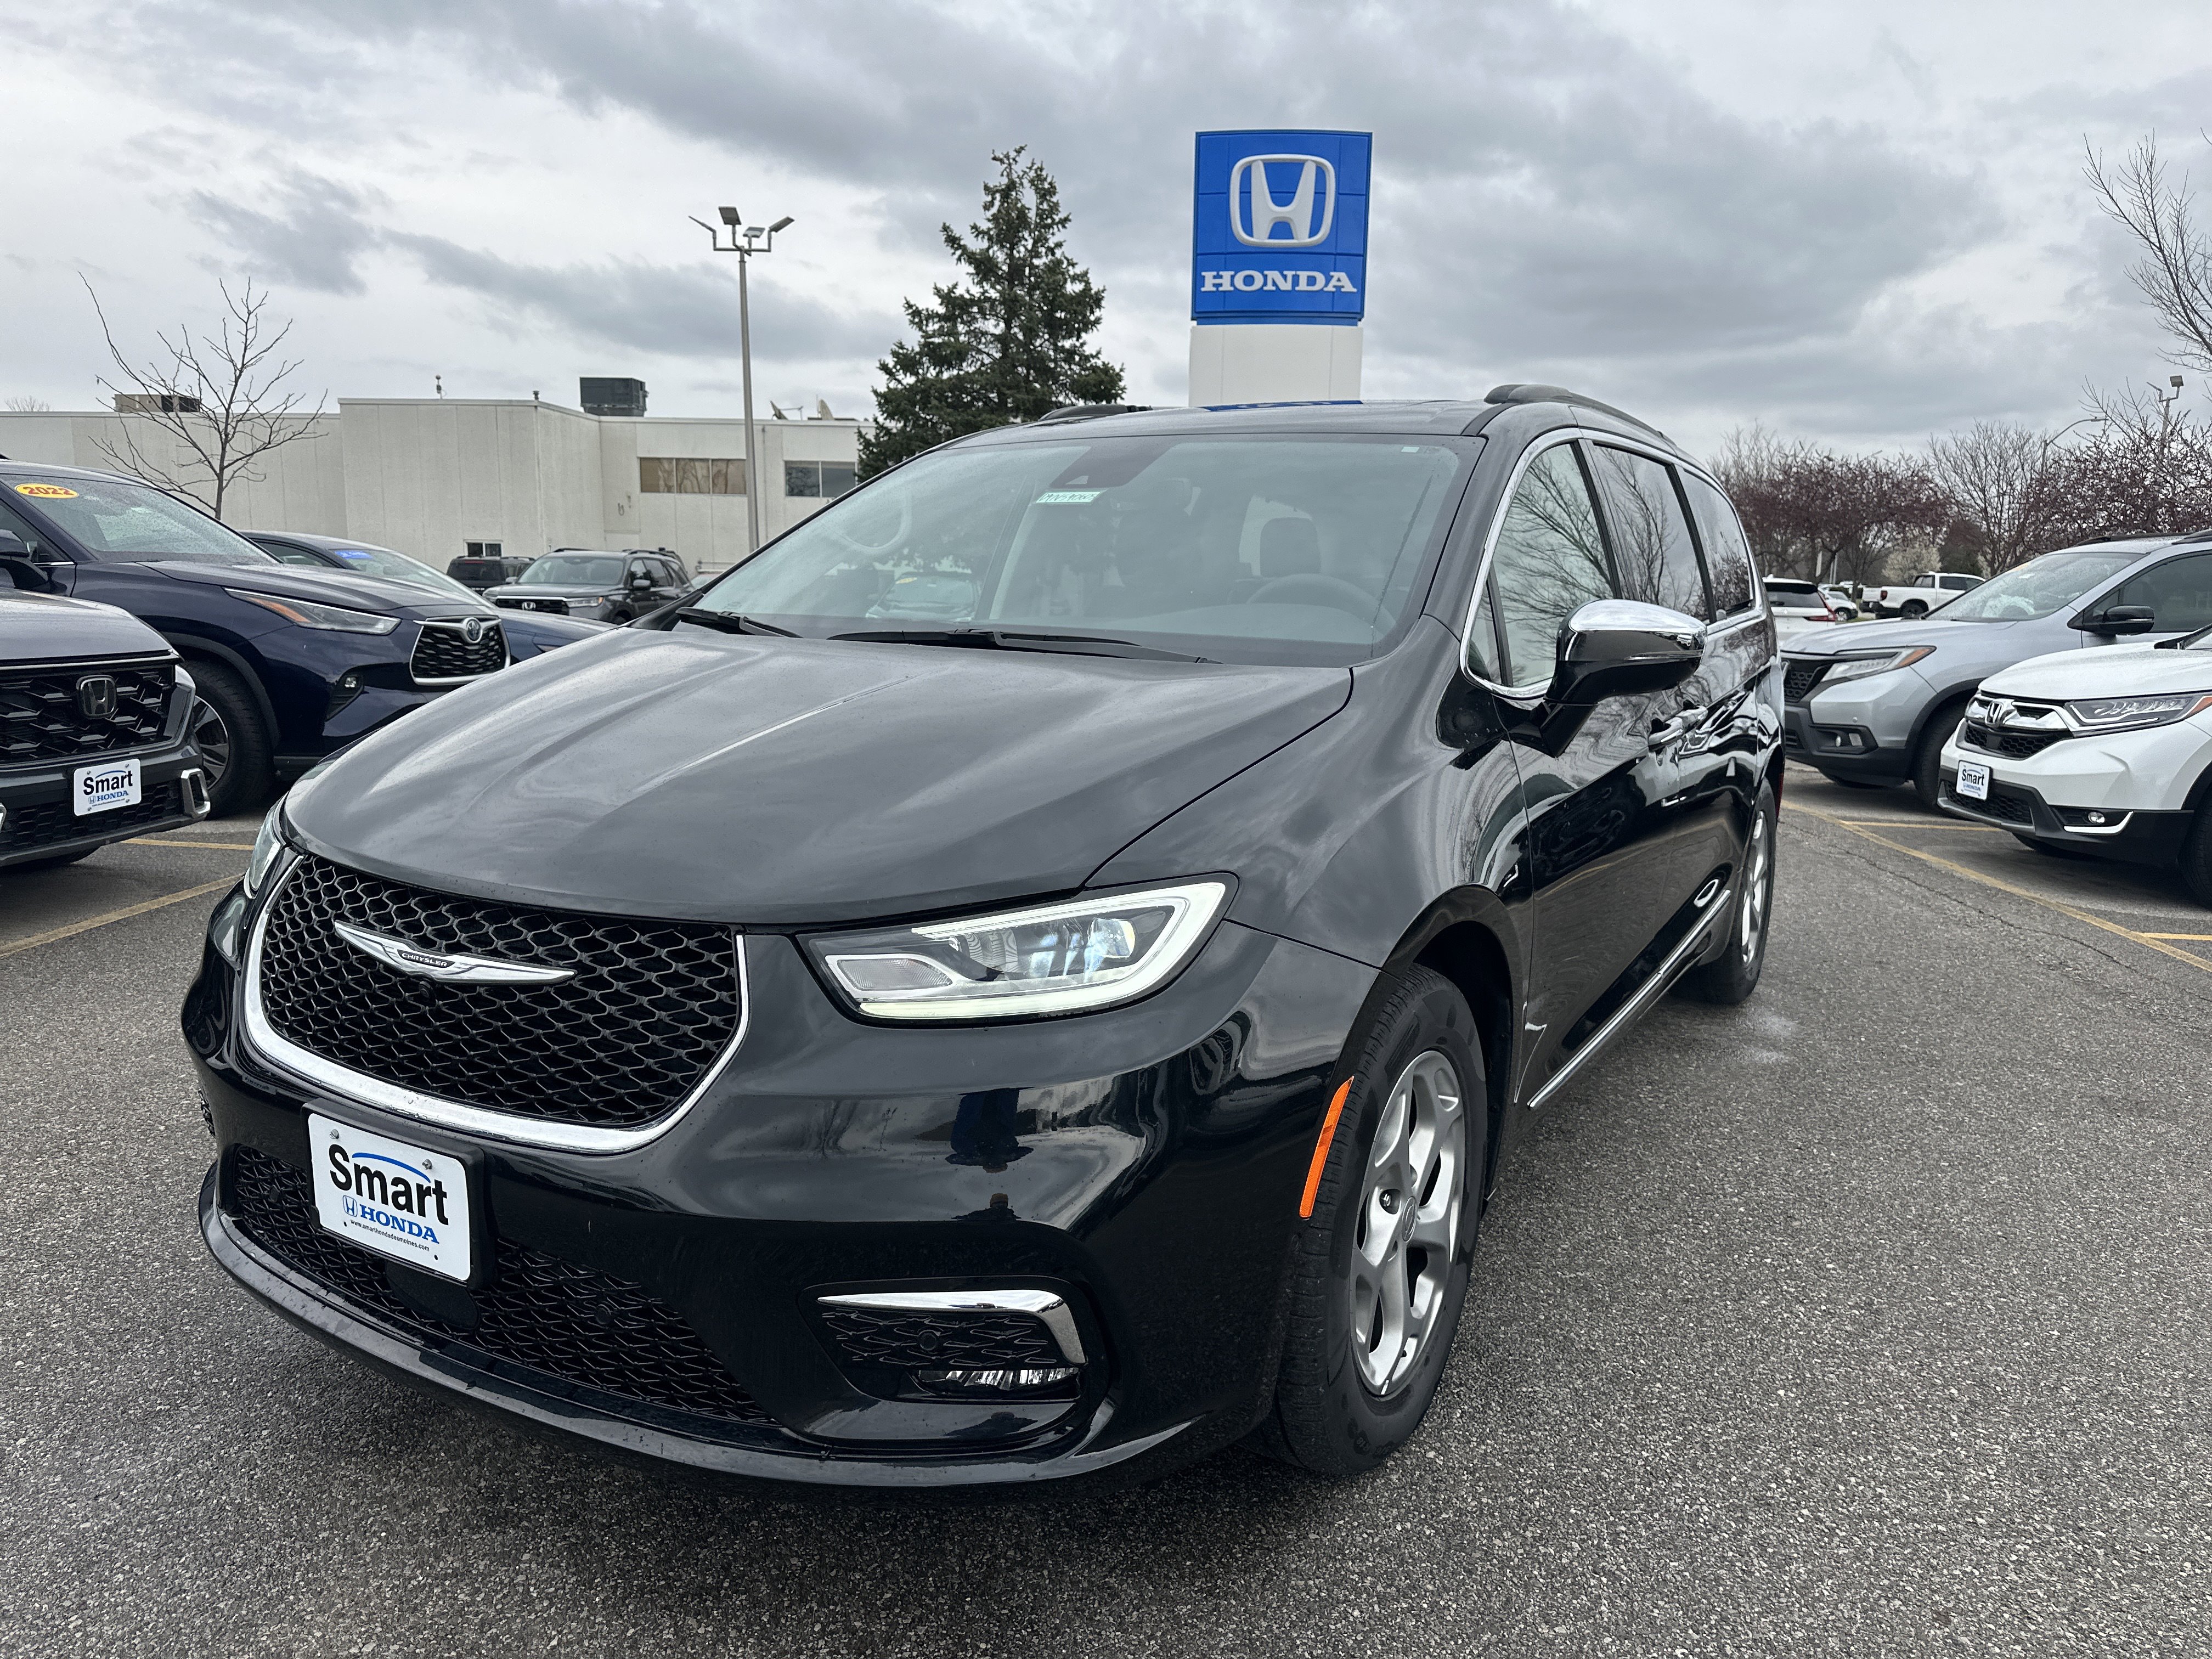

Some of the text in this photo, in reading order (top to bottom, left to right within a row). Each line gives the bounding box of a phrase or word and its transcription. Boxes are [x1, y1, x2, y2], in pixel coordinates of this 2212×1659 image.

[1200, 270, 1357, 292] HONDA
[22, 487, 75, 495] 2022
[83, 770, 133, 795] Smart
[1962, 769, 1985, 786] Smart
[97, 791, 129, 802] HONDA
[402, 952, 448, 967] CHRYSLER
[329, 1144, 449, 1226] Smart
[359, 1204, 439, 1244] HONDA
[351, 1219, 430, 1252] www.smarthondadesmoines.com
